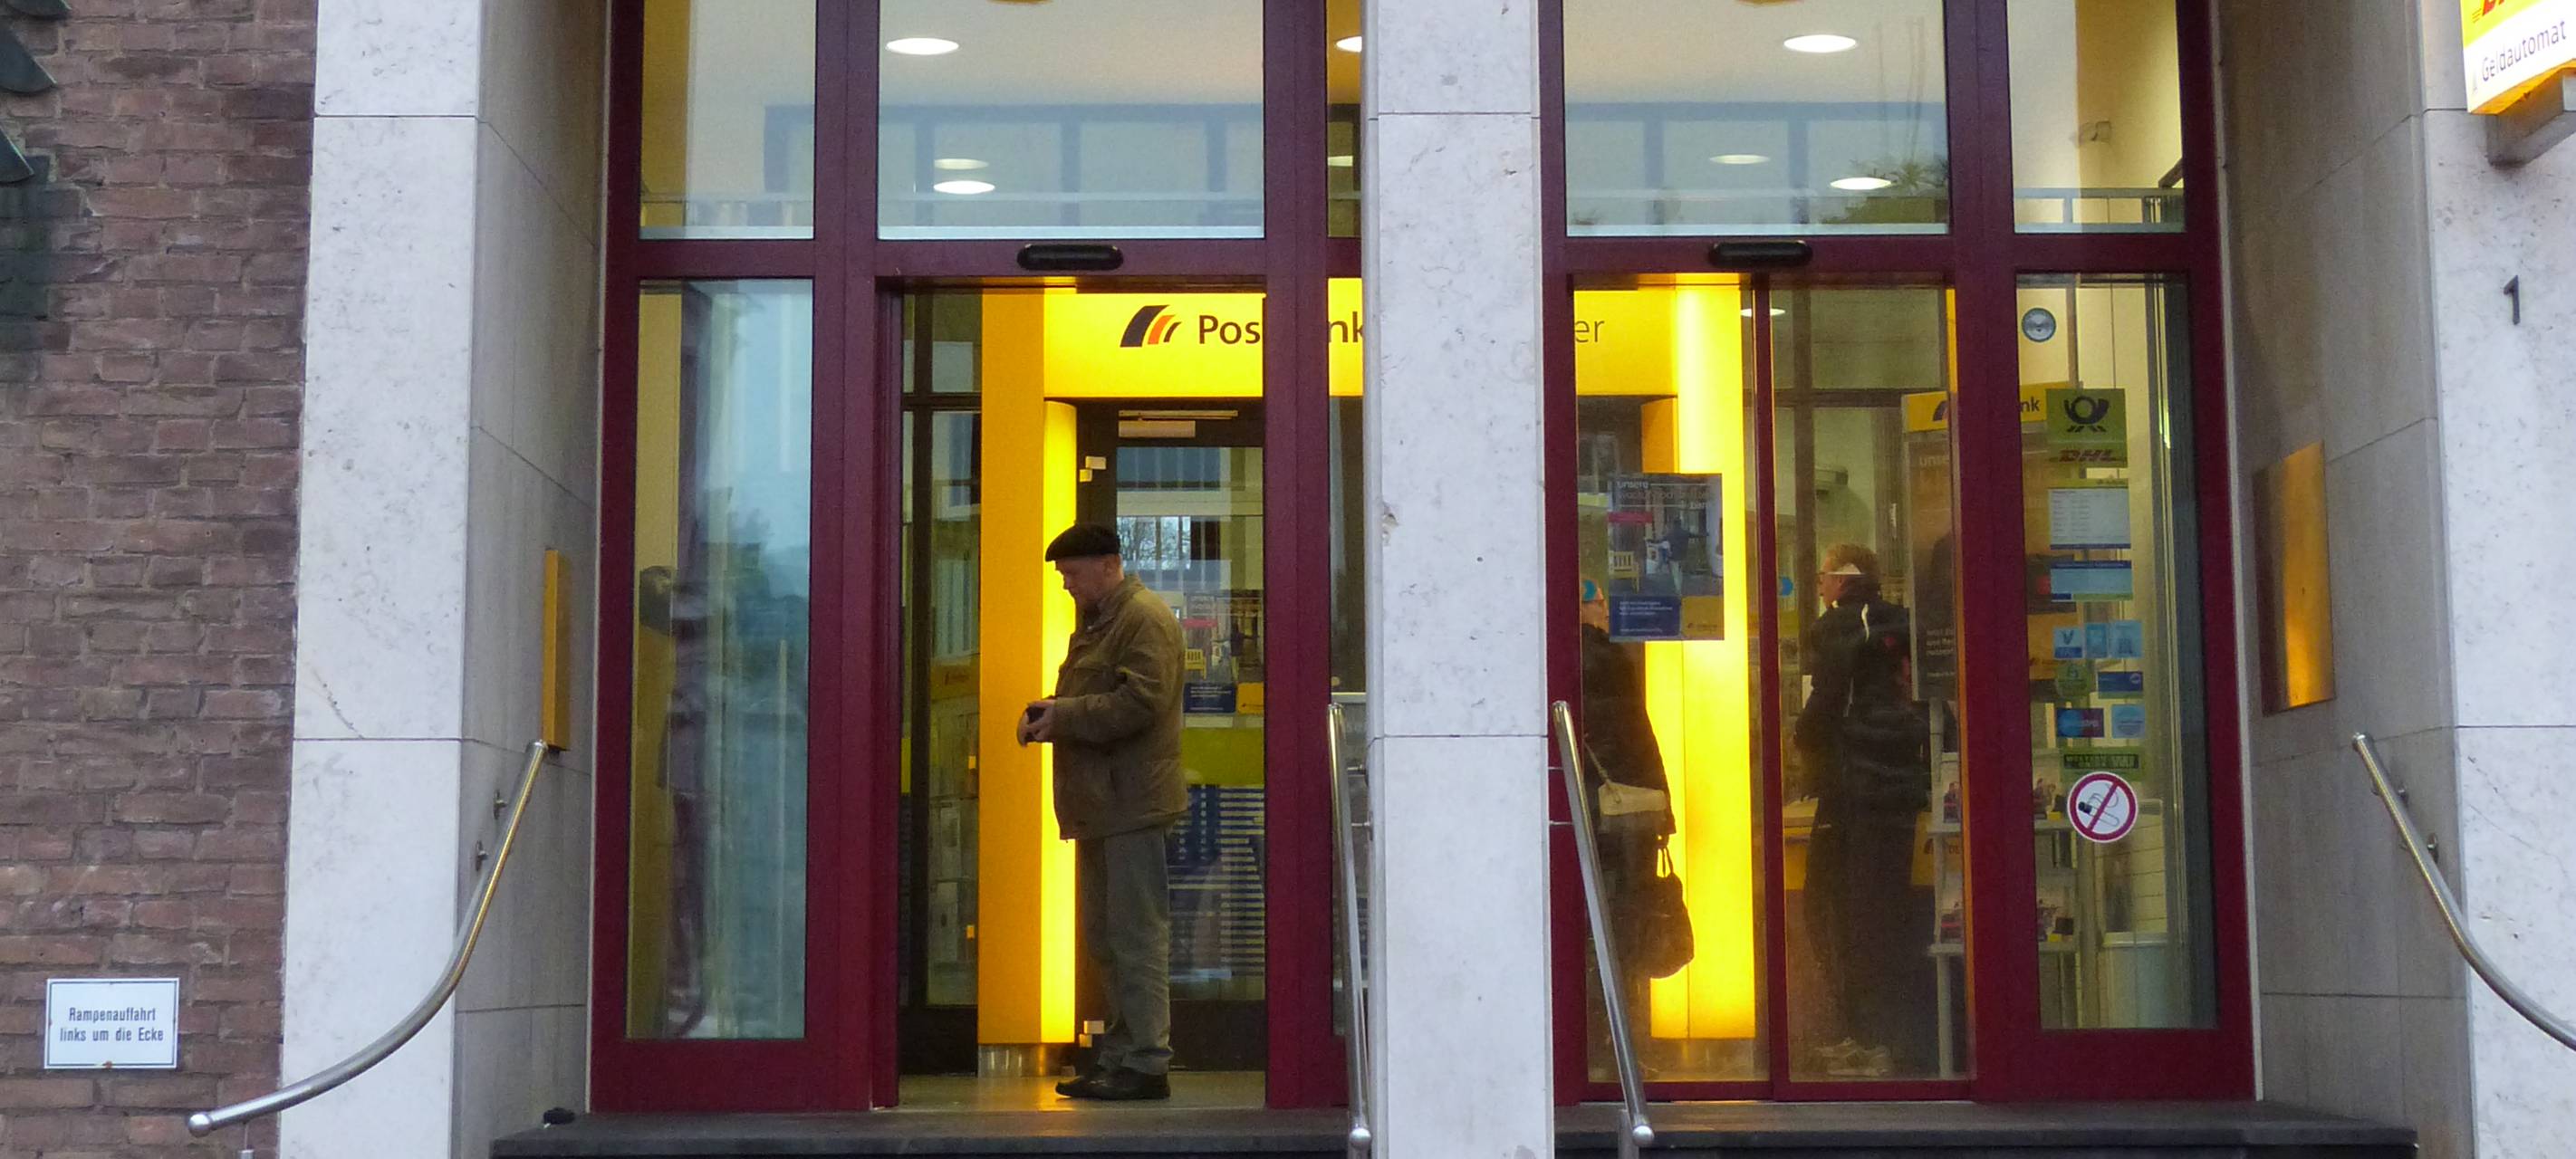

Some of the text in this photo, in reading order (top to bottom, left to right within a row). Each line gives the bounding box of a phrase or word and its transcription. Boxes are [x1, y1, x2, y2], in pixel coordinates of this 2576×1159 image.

[2482, 20, 2567, 82] Geldautomat
[2503, 274, 2521, 326] 1
[69, 1007, 156, 1023] Rampenauffahrt
[60, 1027, 164, 1041] links um die Ecke
